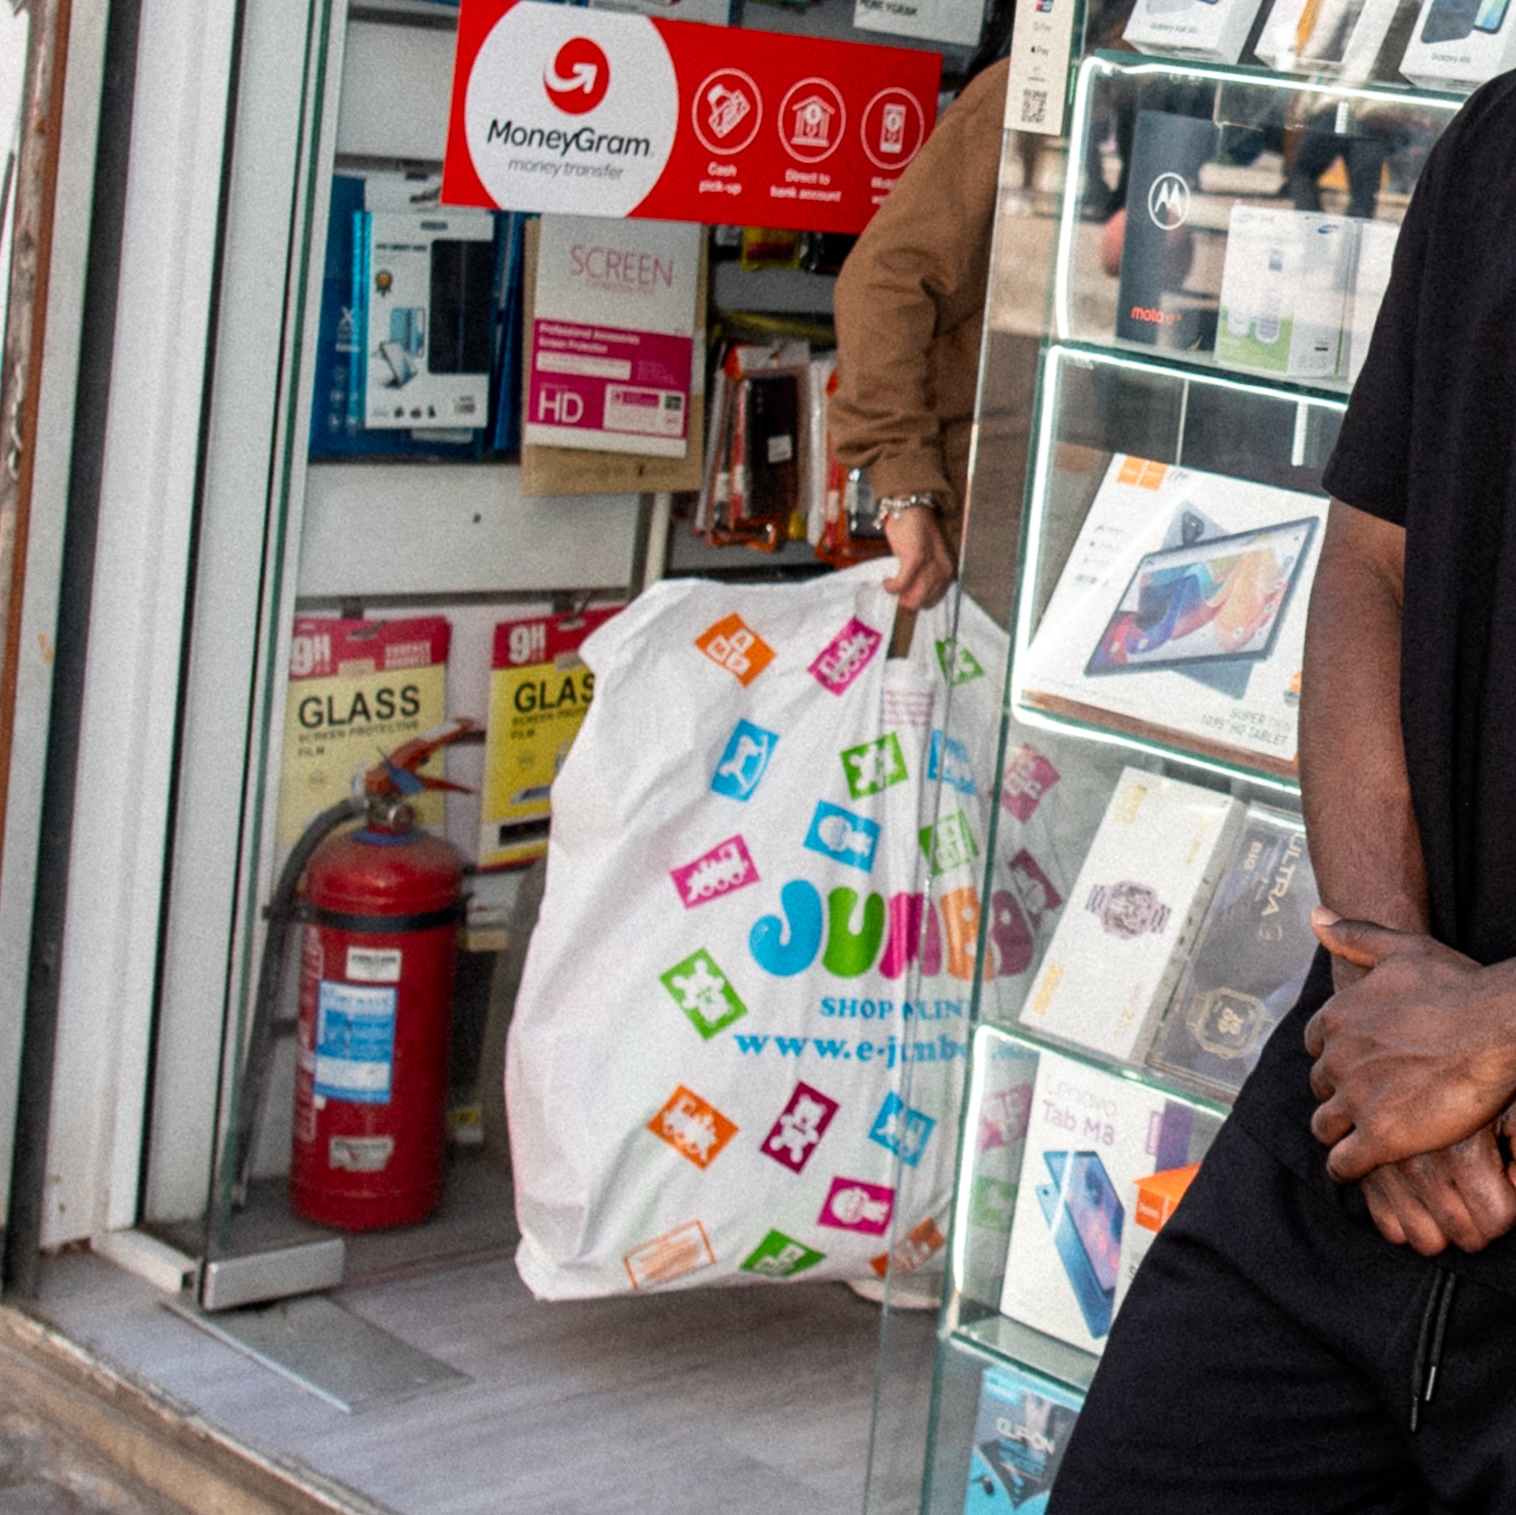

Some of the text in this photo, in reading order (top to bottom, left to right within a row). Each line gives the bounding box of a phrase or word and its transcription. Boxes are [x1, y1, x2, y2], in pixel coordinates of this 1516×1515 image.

[486, 118, 651, 159] MoneyGram
[508, 157, 625, 181] money transfer
[707, 160, 737, 178] Cash
[786, 168, 831, 185] Direct to
[699, 178, 742, 197] pick-up
[770, 184, 842, 203] bank account
[569, 243, 676, 288] SCREEN
[1131, 305, 1164, 324] moto
[538, 389, 584, 424] HD
[291, 634, 331, 676] 9H
[509, 624, 547, 665] 9H
[298, 683, 421, 730] GLASS
[514, 672, 596, 714] GLAS
[1243, 840, 1264, 872] BIG
[1262, 831, 1307, 917] ULTRA
[821, 996, 895, 1020] SHOP
[1042, 1099, 1116, 1146] Tab M8
